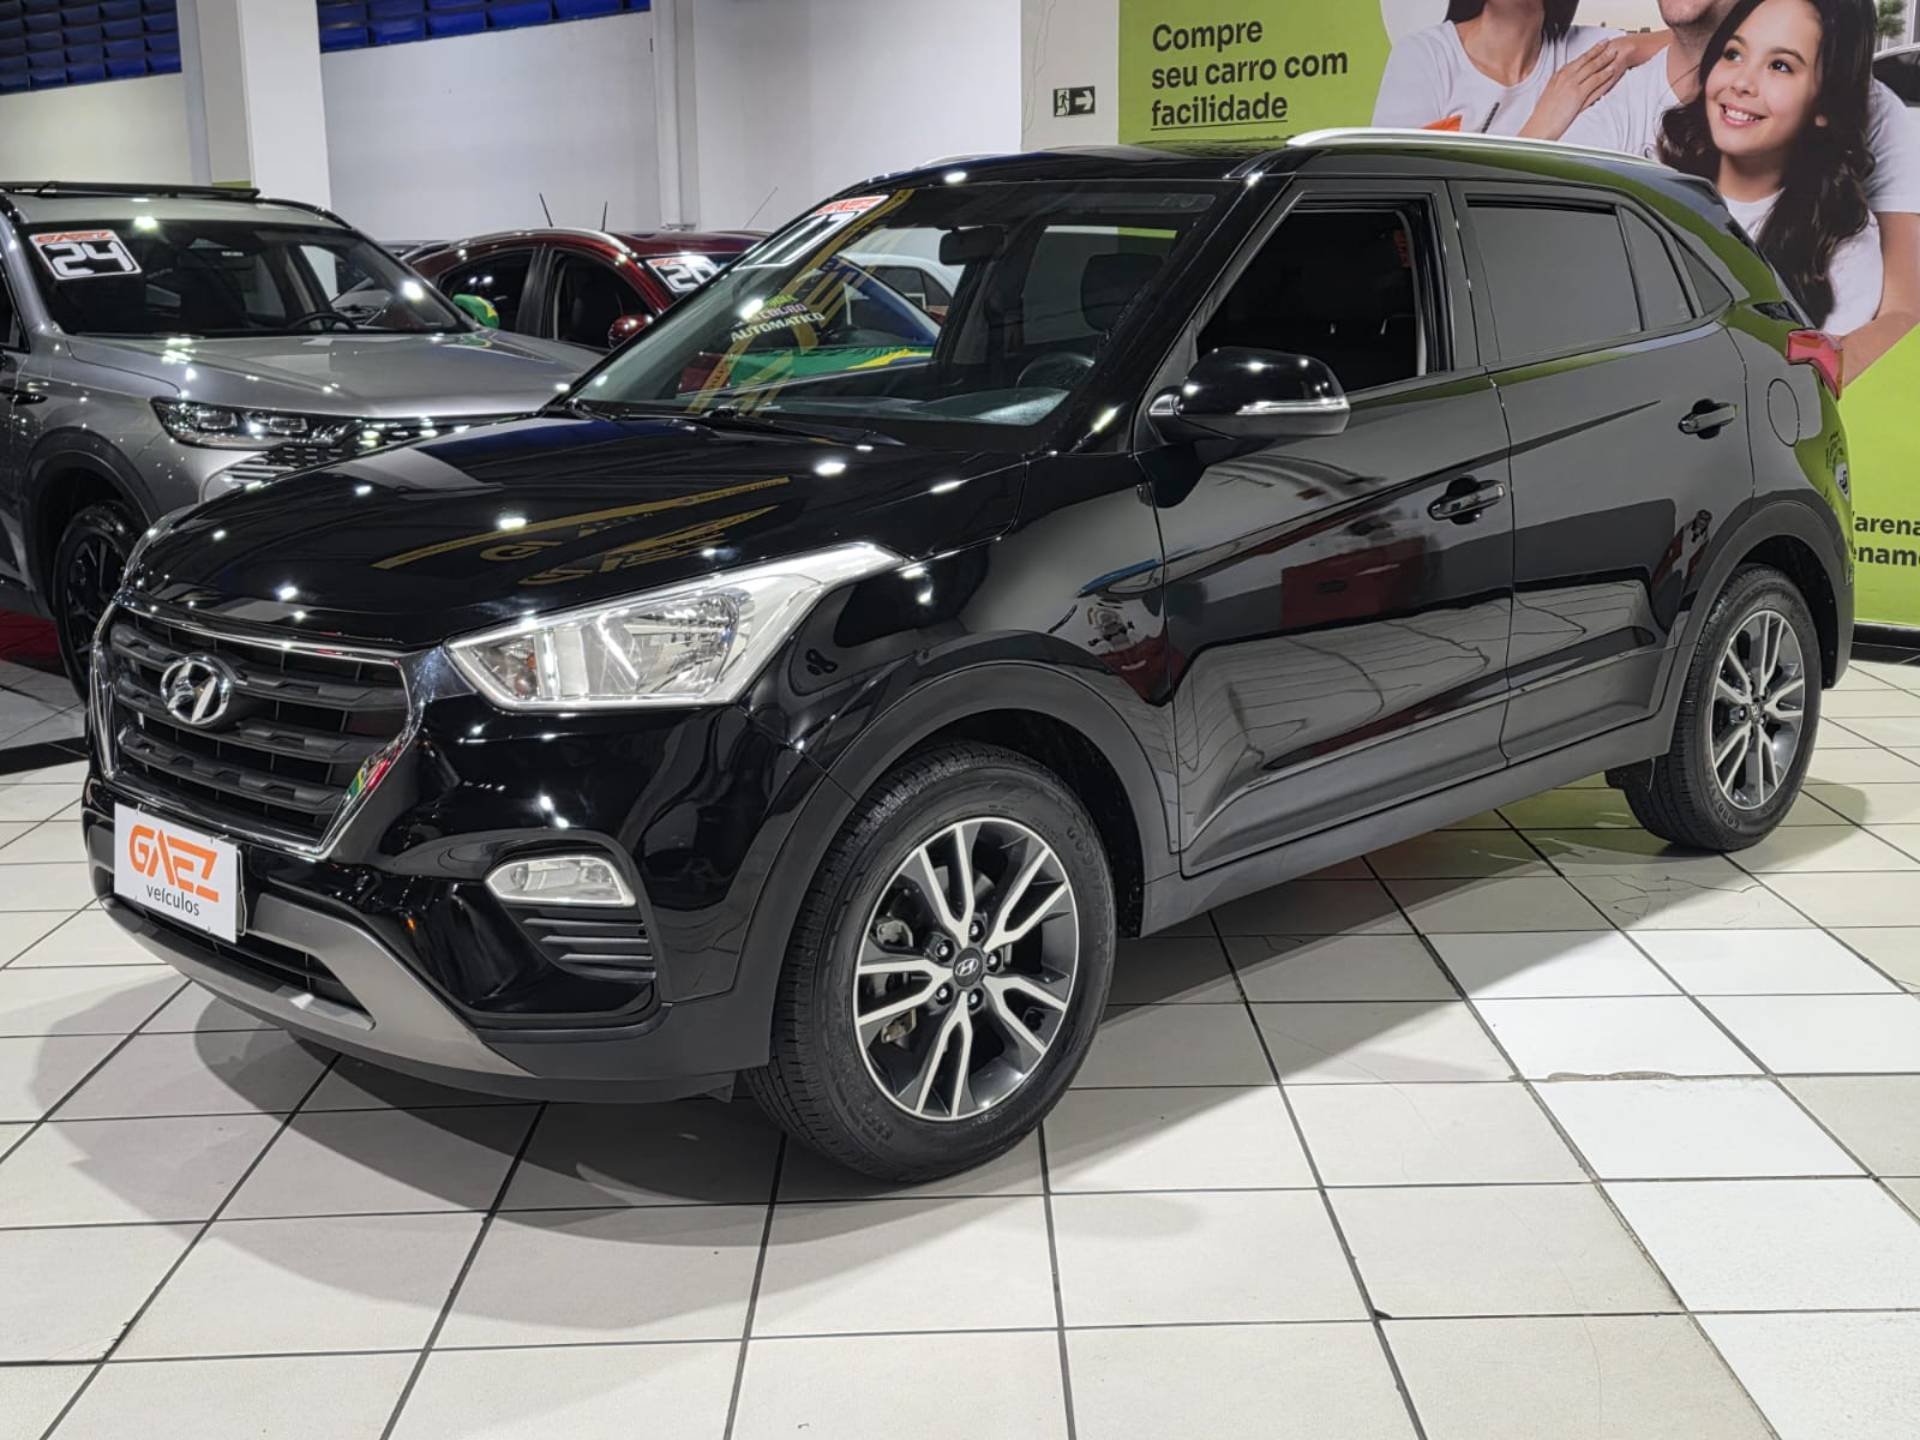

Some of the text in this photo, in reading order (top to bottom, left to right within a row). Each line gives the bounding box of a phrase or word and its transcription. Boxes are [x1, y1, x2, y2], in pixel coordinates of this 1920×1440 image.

[1152, 20, 1263, 52] Compre
[1152, 51, 1348, 89] seu carro com
[1152, 92, 1288, 128] facilidade
[45, 240, 134, 276] 24
[1852, 511, 1920, 536] arena
[1853, 546, 1920, 567] nam
[129, 825, 219, 903] GAEZ
[146, 885, 200, 916] veículos
